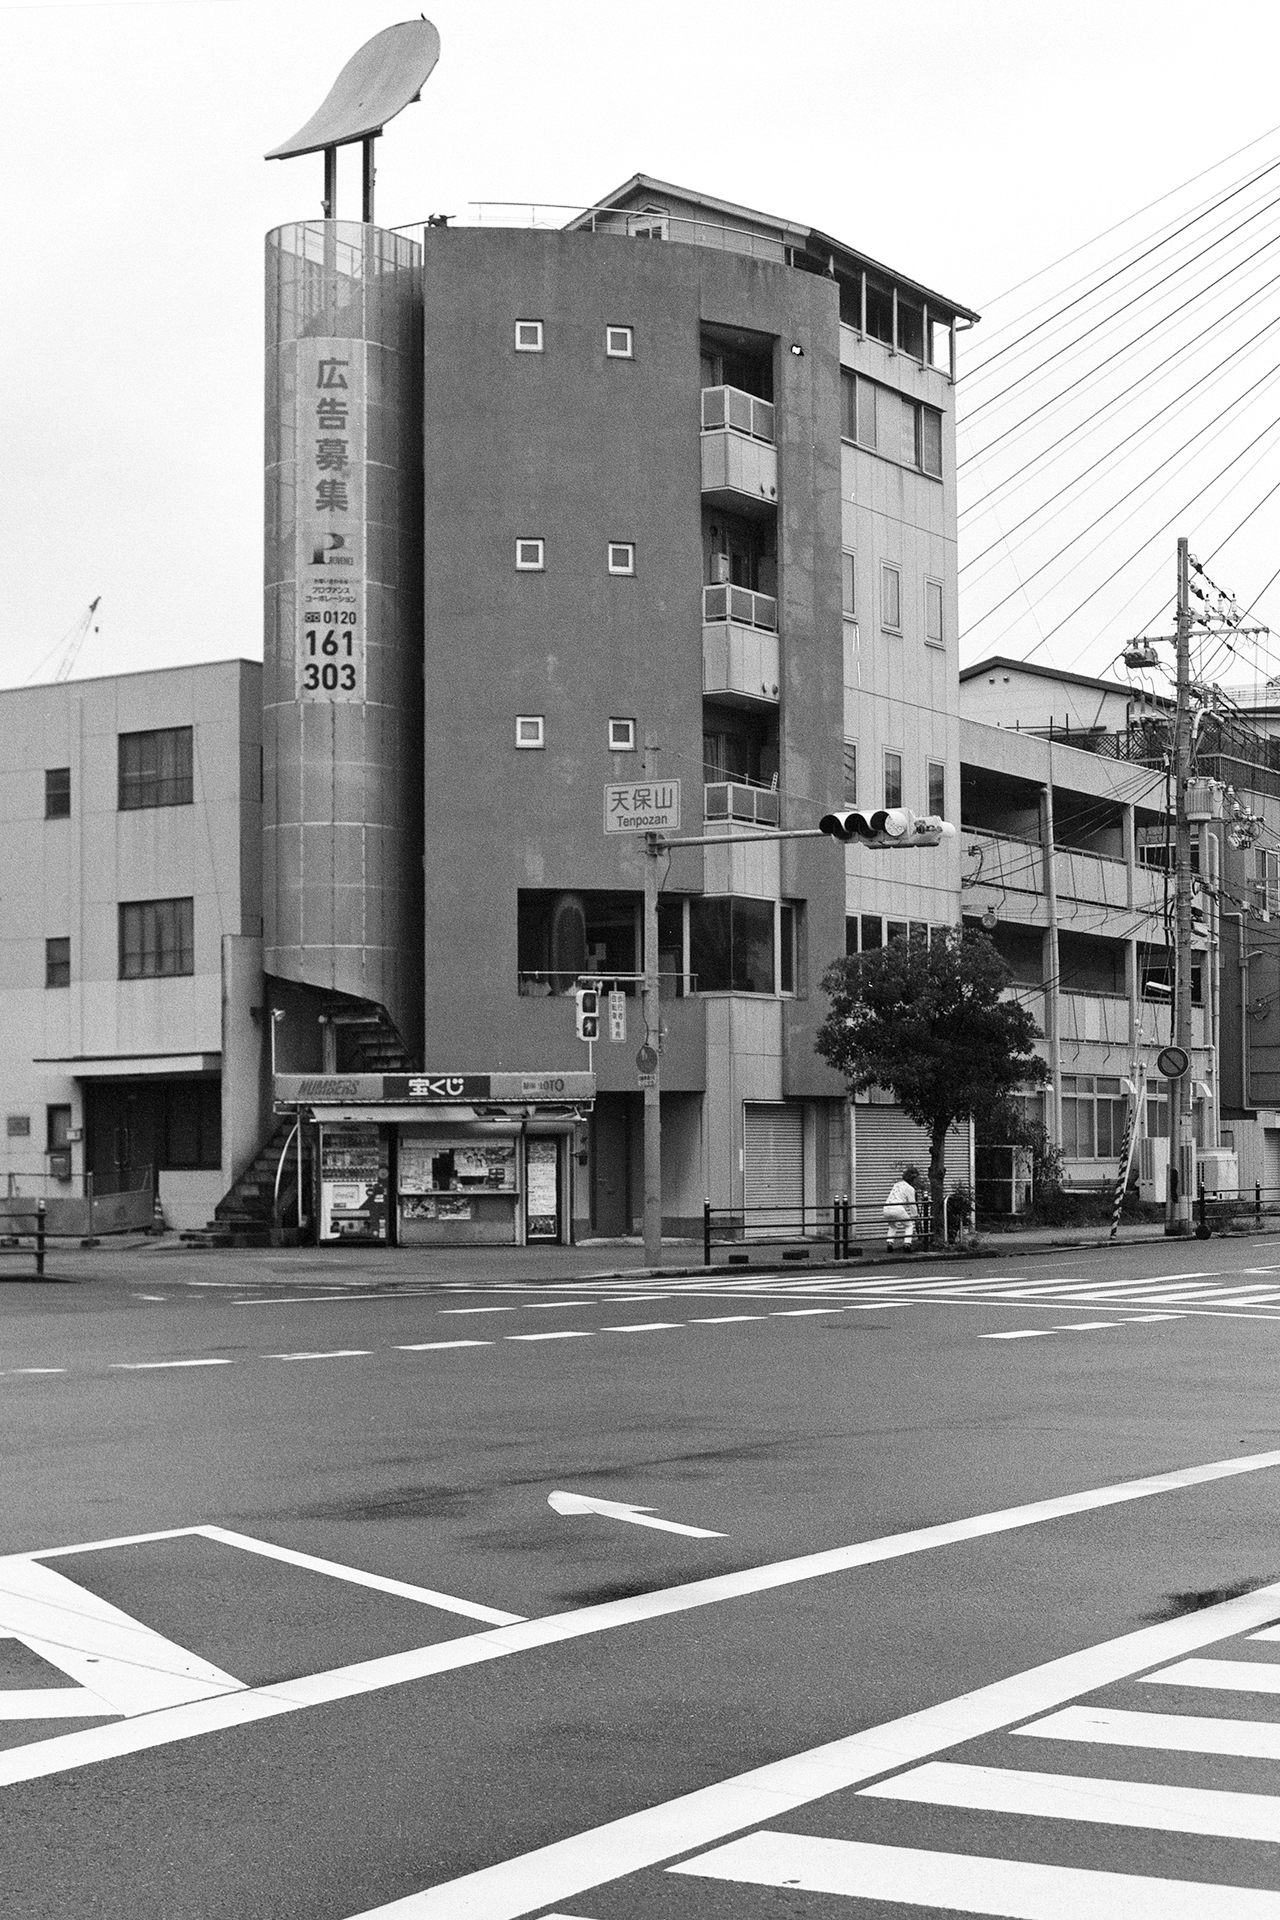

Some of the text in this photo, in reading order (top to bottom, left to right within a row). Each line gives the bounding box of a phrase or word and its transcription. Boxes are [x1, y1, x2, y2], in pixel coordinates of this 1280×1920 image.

[316, 357, 349, 512] 広告募集
[323, 610, 357, 625] 0120
[305, 630, 353, 657] 161
[303, 663, 357, 691] 303
[610, 787, 673, 812] 天保山
[617, 814, 667, 828] Tenpozan
[298, 1079, 360, 1096] NUMBERS
[408, 1078, 464, 1097] 宝くじ
